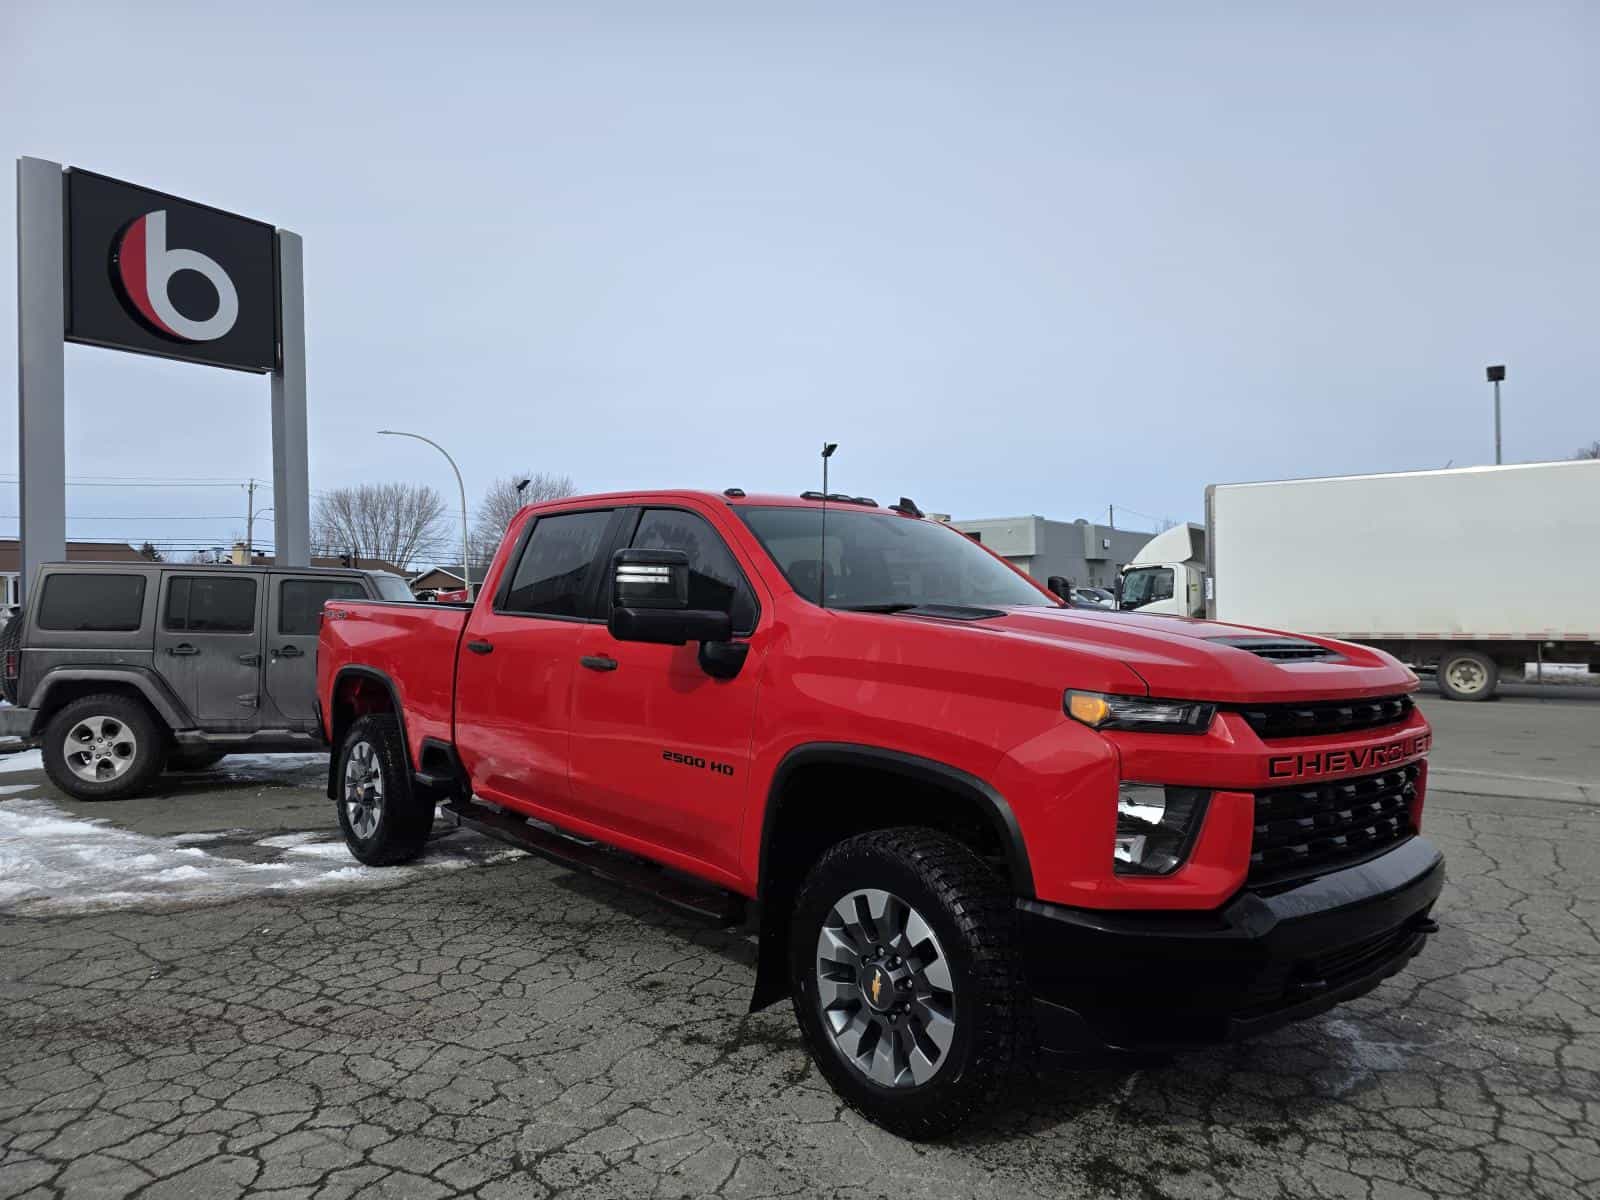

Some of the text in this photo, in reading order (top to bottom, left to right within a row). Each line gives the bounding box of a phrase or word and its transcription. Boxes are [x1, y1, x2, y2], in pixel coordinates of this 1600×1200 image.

[144, 209, 239, 341] b
[662, 750, 734, 776] 2500 HD
[1268, 734, 1432, 779] CHEVROLET
